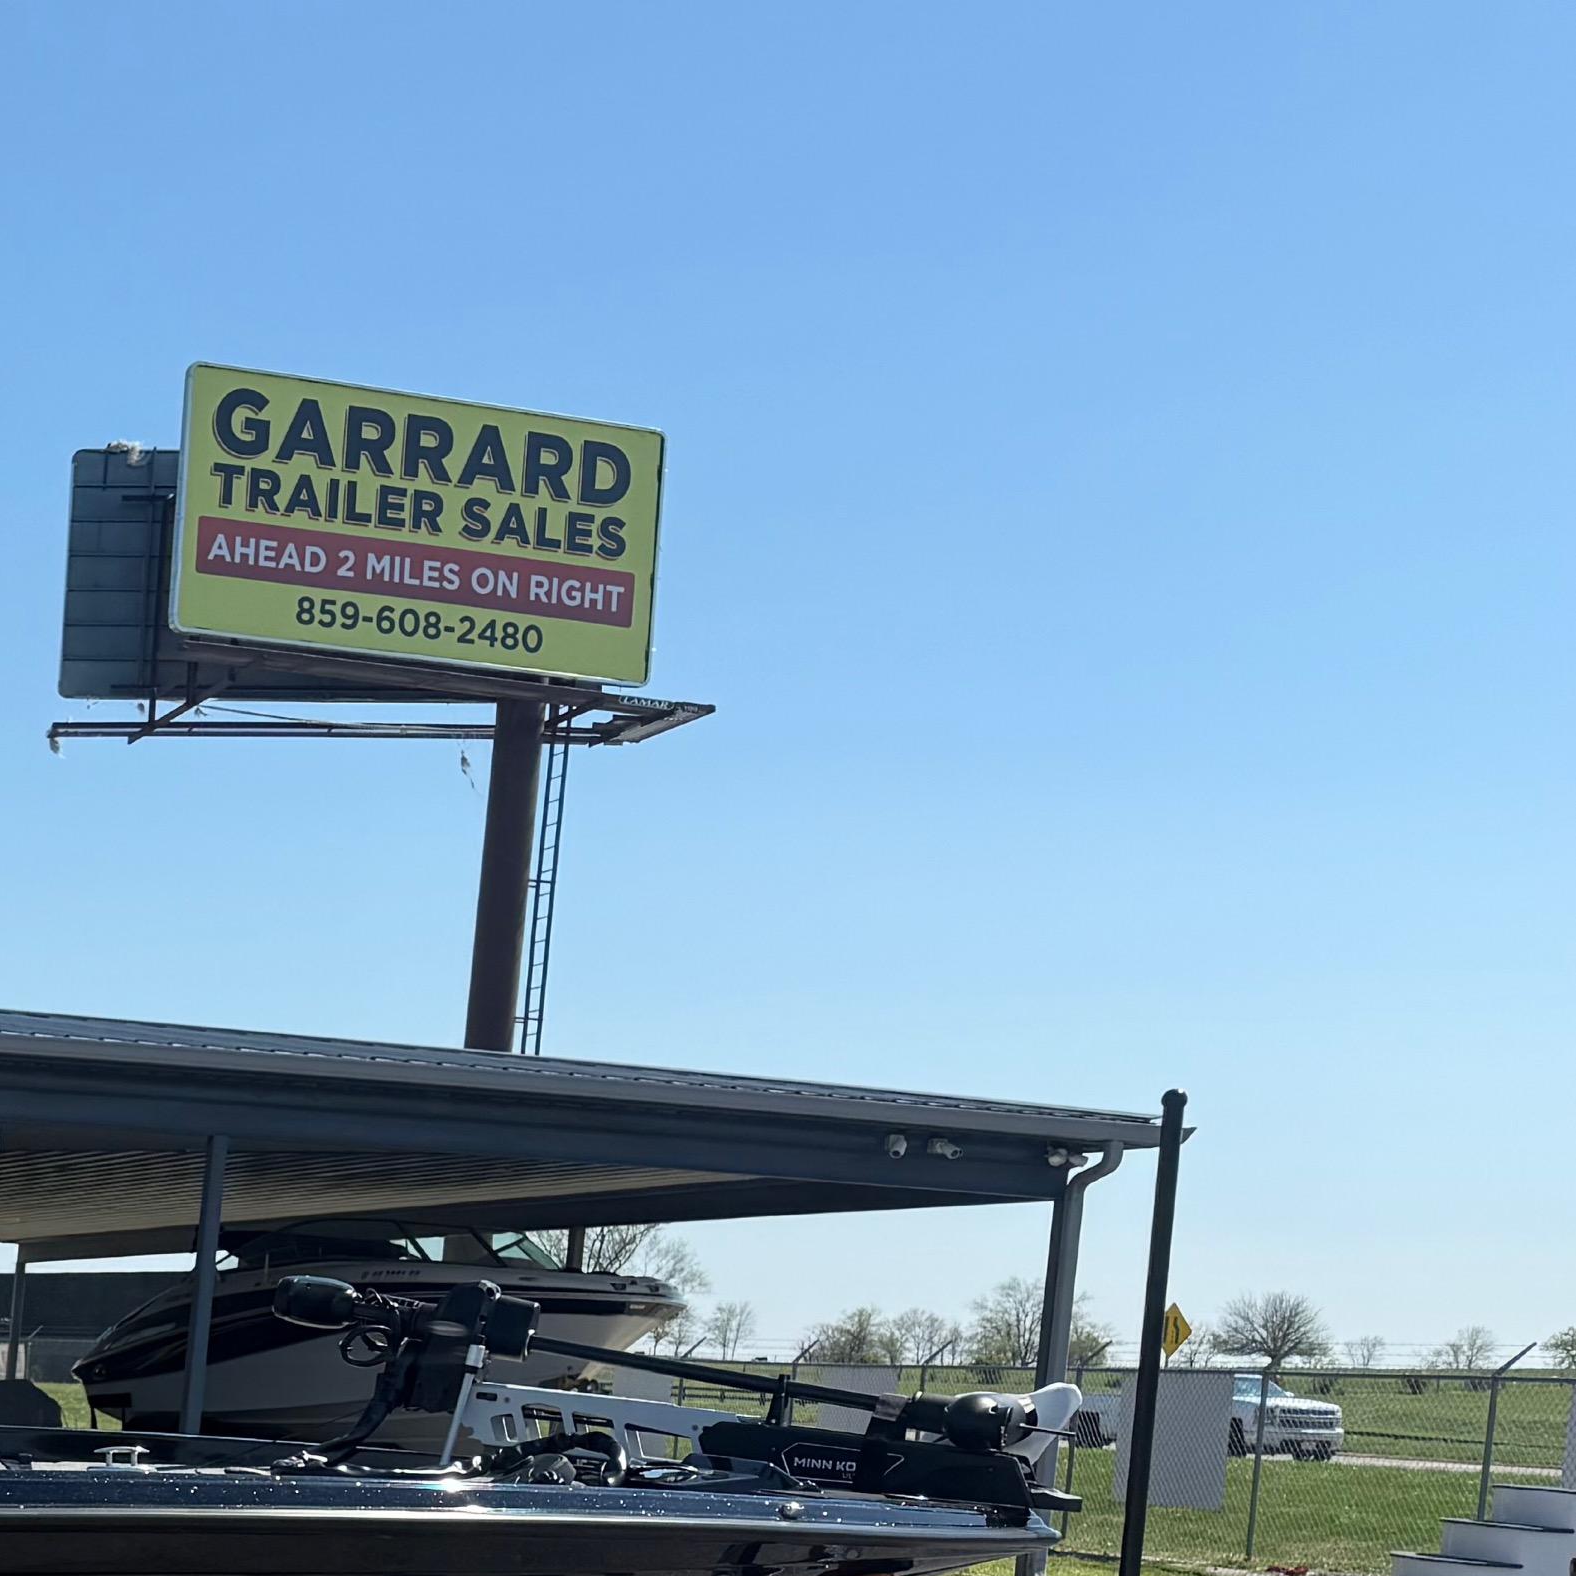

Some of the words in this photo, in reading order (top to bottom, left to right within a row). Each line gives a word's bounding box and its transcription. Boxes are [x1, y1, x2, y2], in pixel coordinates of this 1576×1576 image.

[213, 388, 632, 507] GARRARD
[211, 462, 444, 535] TRAILER
[460, 497, 626, 560] SALES
[208, 533, 327, 574] AHEAD
[337, 550, 355, 578] 2
[366, 553, 460, 592] MILES
[471, 567, 519, 600] ON
[529, 575, 626, 612] RIGHT
[296, 596, 544, 654] 859-608-2480
[624, 696, 669, 710] LAMAR
[794, 1456, 832, 1470] MINN
[836, 1461, 857, 1472] KO
